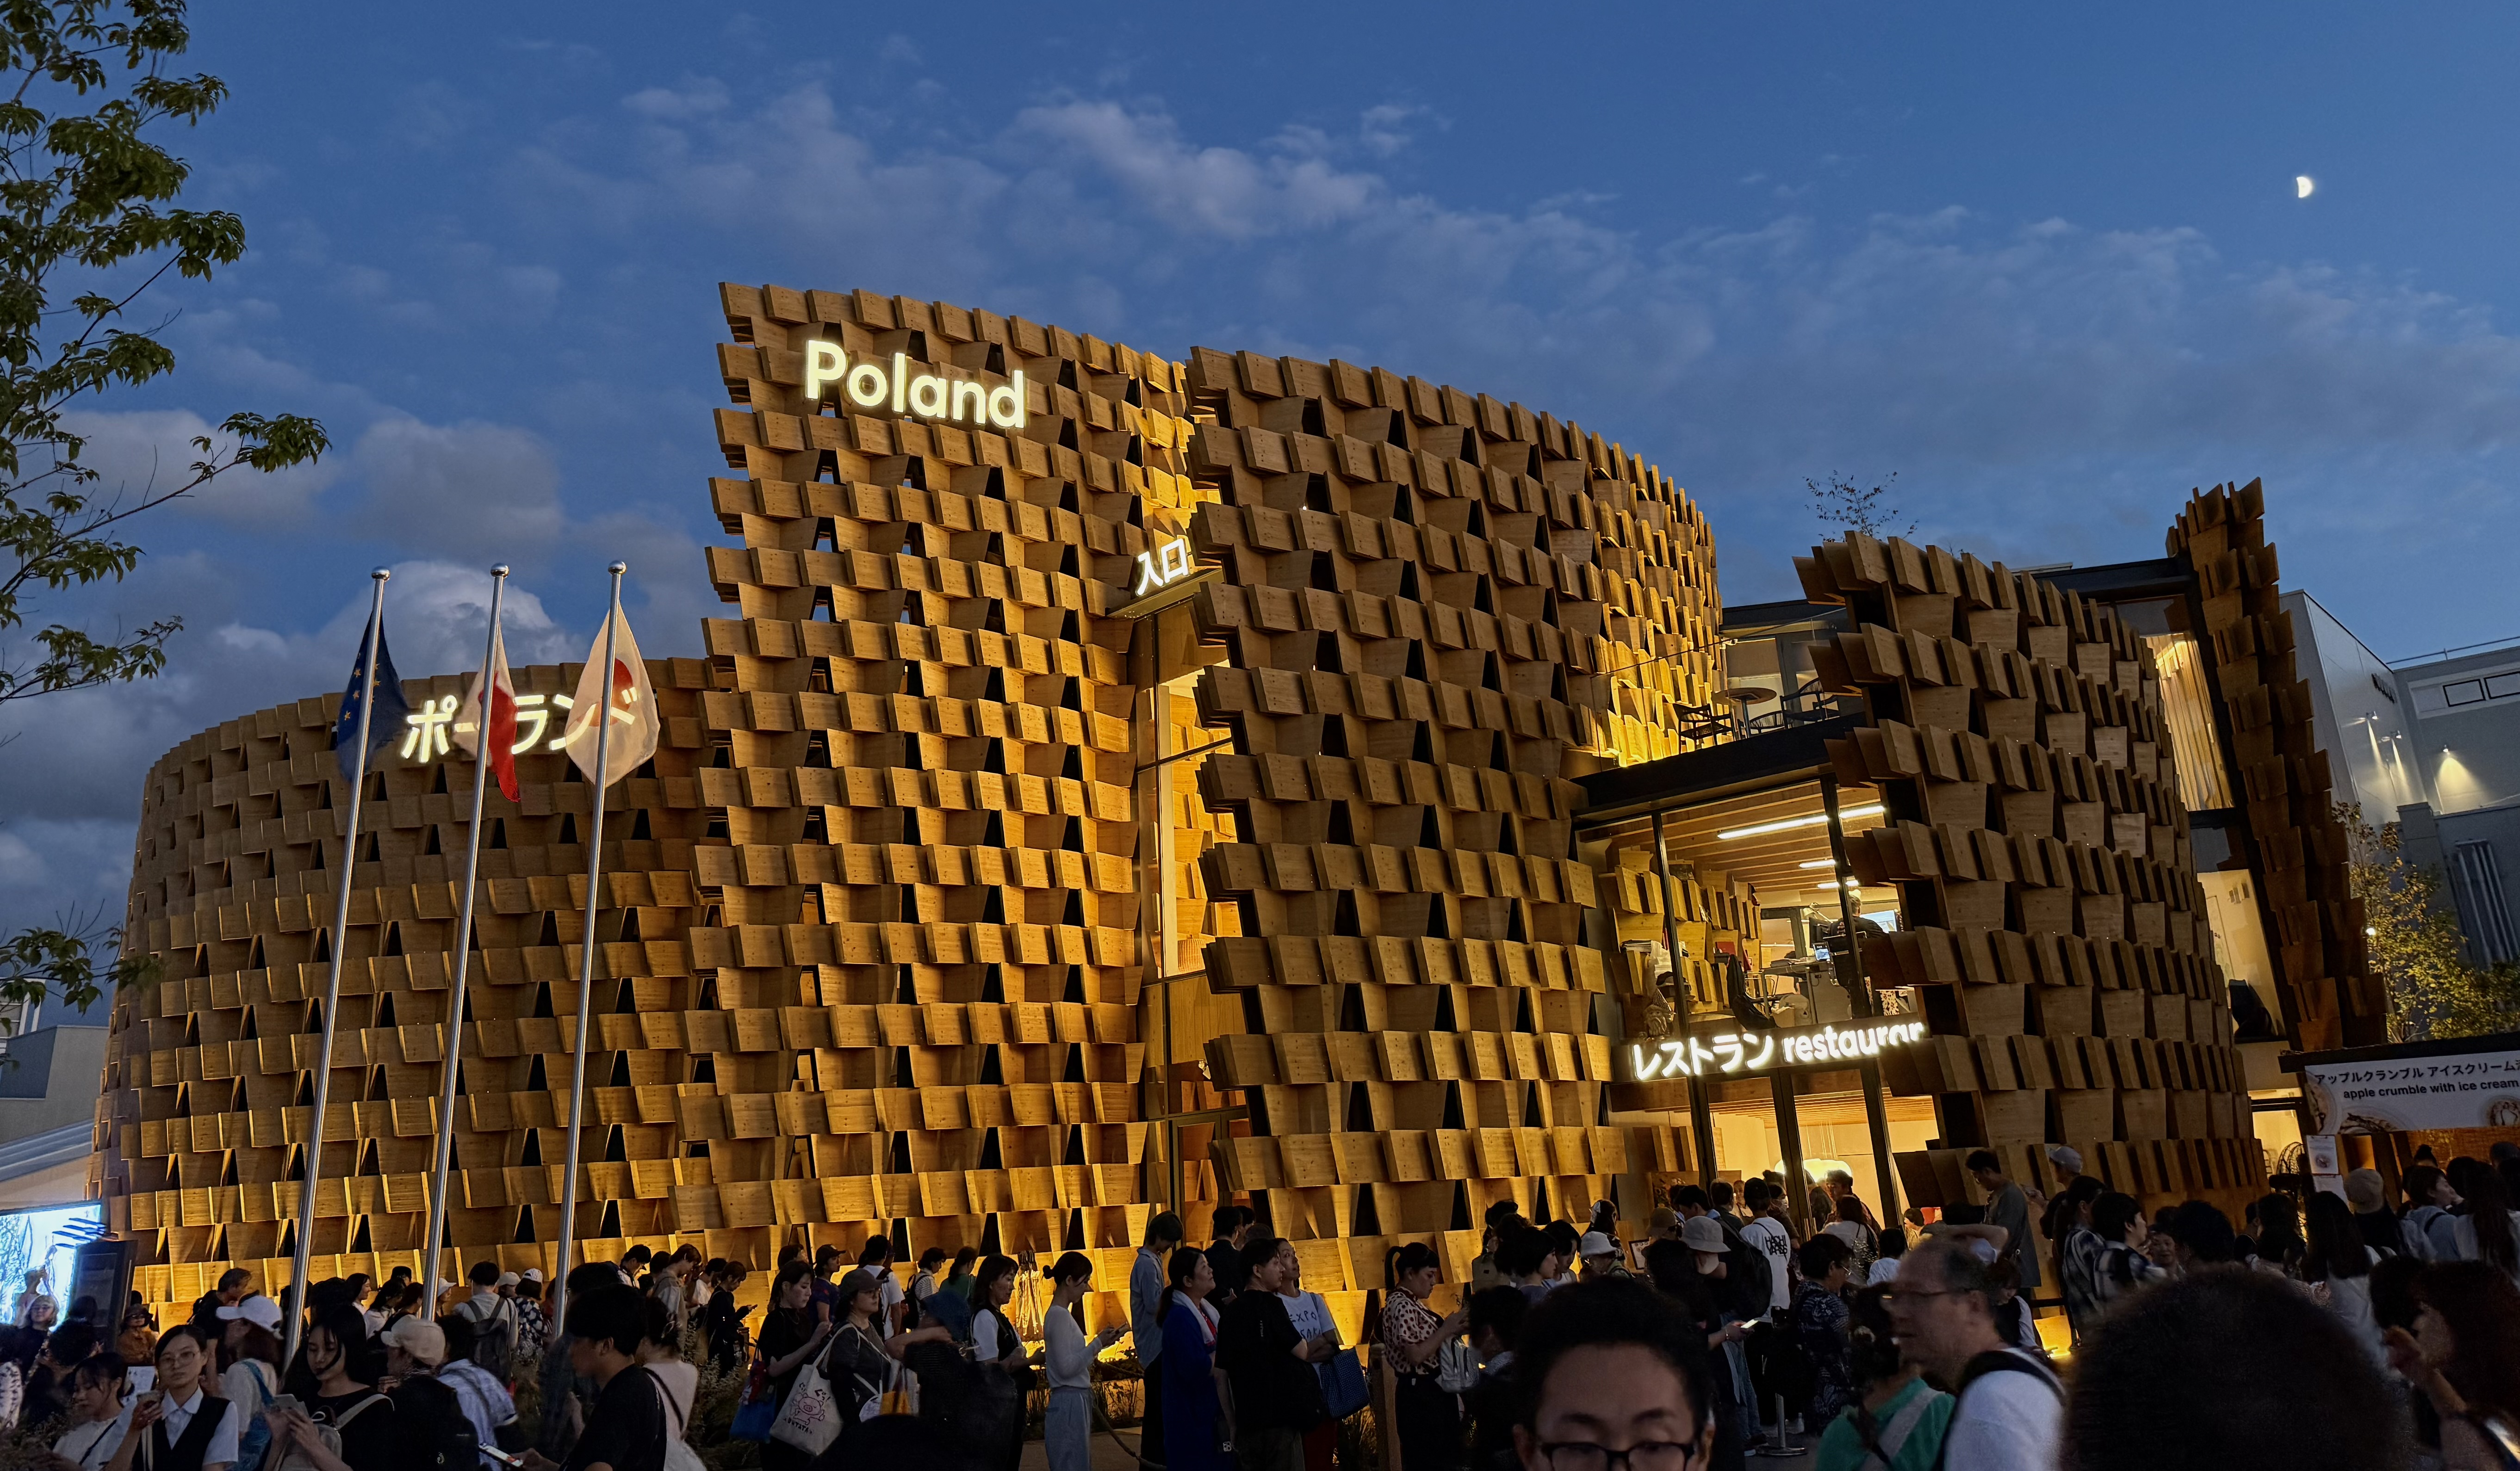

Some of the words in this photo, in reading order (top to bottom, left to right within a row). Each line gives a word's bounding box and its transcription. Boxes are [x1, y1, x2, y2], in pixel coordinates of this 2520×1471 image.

[806, 339, 1024, 429] Poland
[1136, 538, 1189, 596] 入口
[1632, 1033, 1774, 1080] レストラン
[2314, 1067, 2424, 1085] アップルクランブル
[2427, 1060, 2520, 1077] アイスクリーム
[2344, 1088, 2376, 1100] apple
[2379, 1085, 2427, 1097] crumble
[2430, 1082, 2456, 1093] with
[2458, 1082, 2477, 1091] ice
[2480, 1080, 2519, 1090] cream
